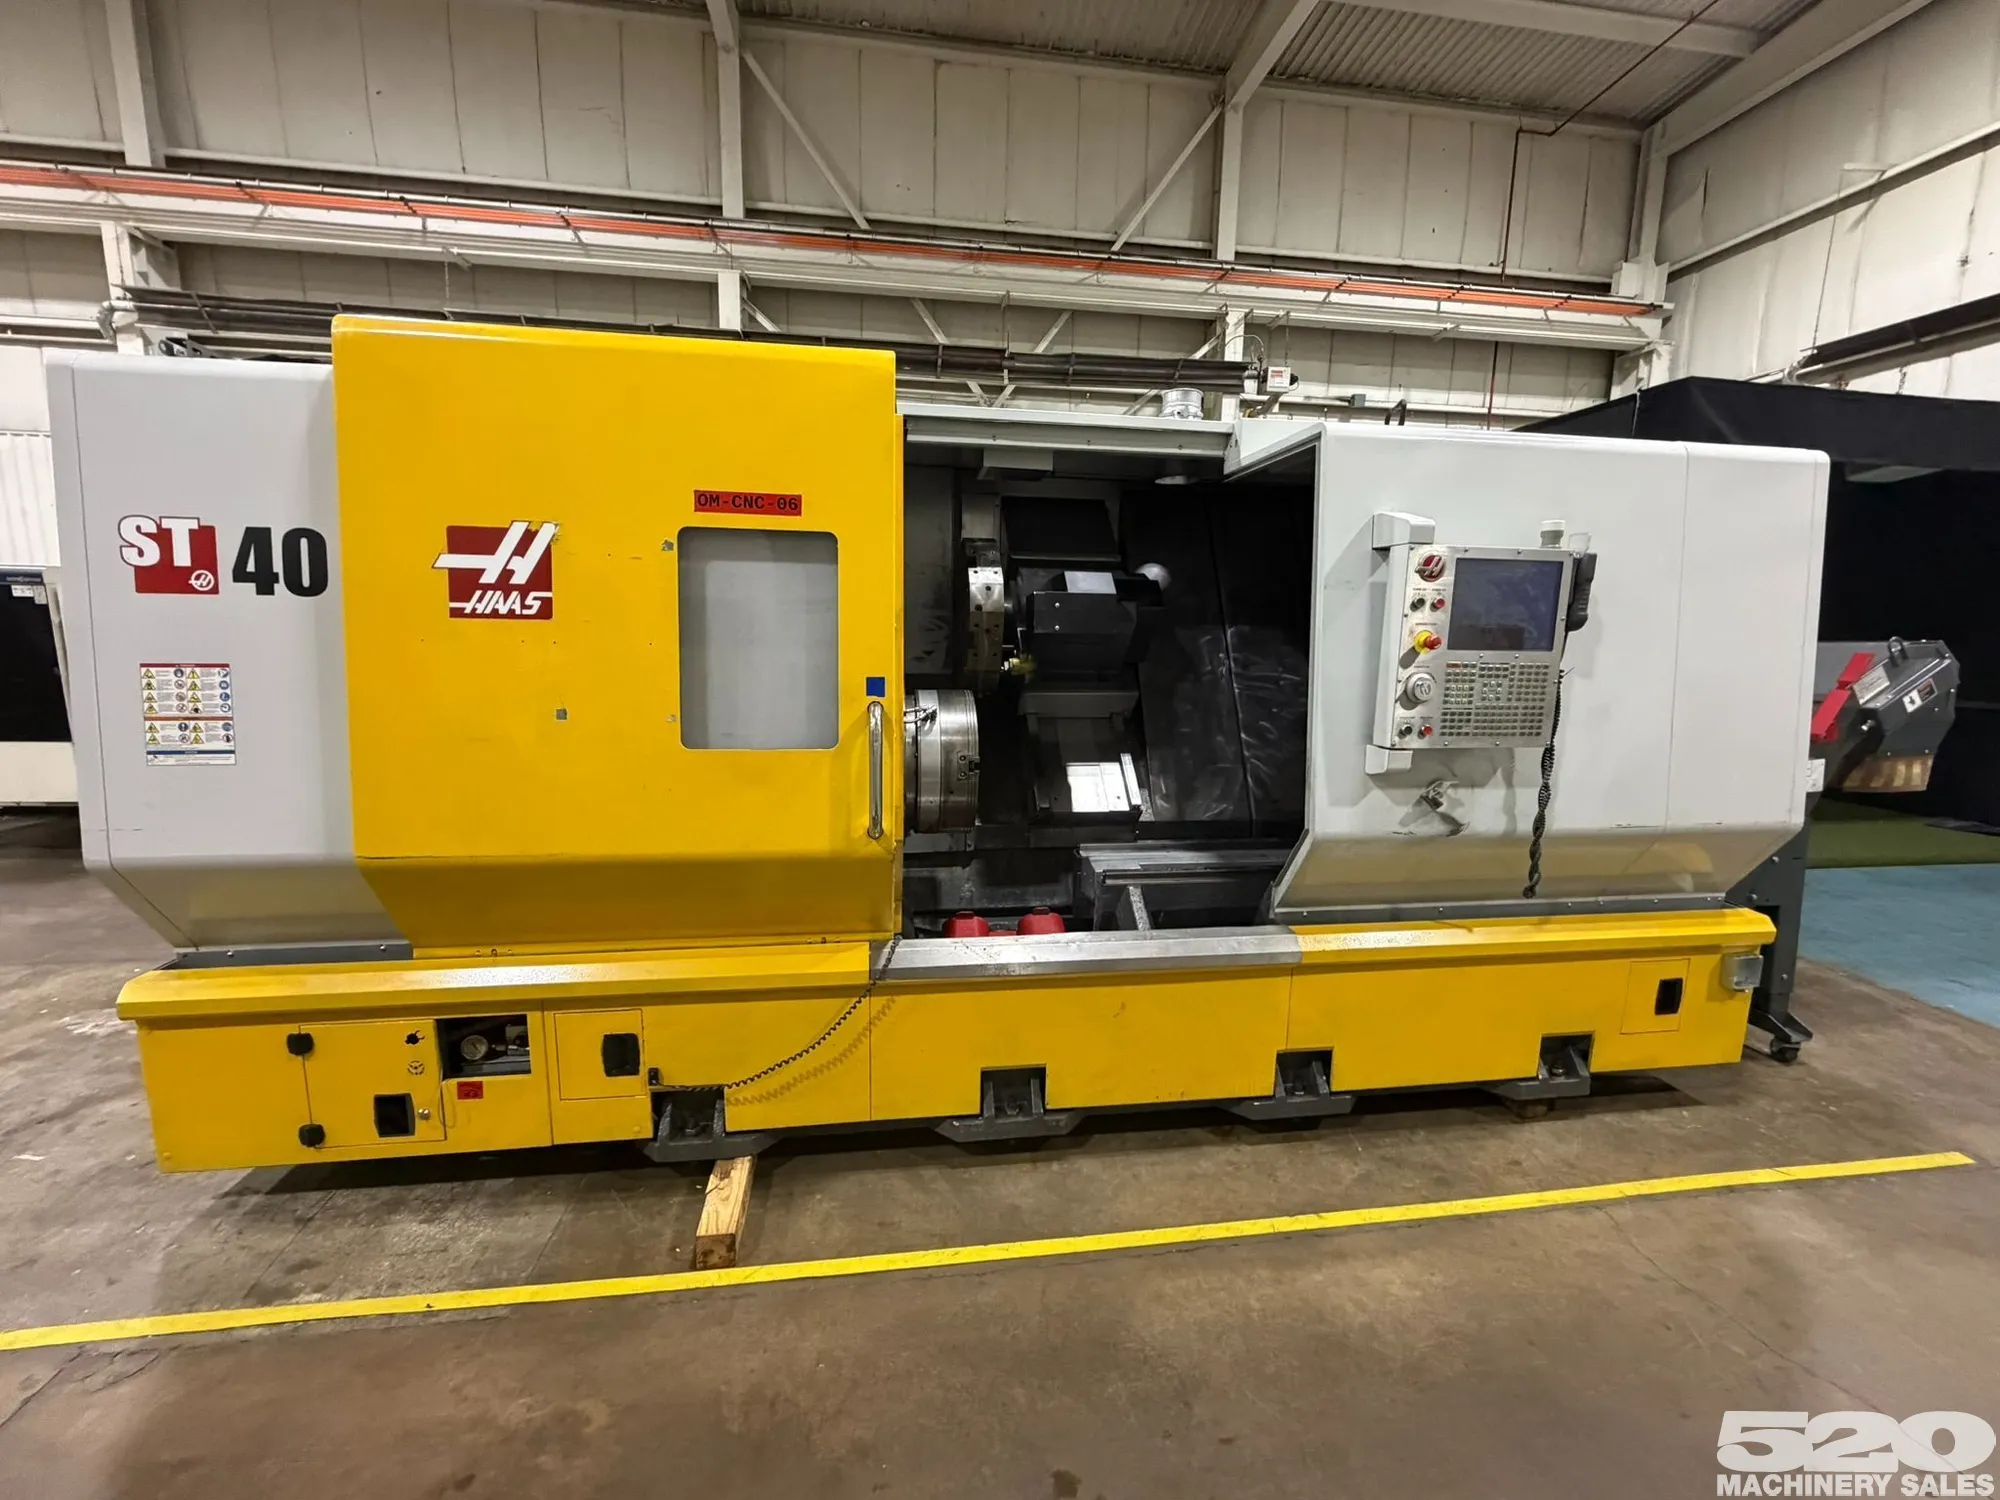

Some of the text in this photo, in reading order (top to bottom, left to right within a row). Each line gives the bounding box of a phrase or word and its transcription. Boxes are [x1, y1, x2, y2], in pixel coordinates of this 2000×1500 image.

[697, 493, 798, 511] OM-CNC-06
[118, 514, 329, 597] ST 40
[449, 590, 553, 615] HAAS
